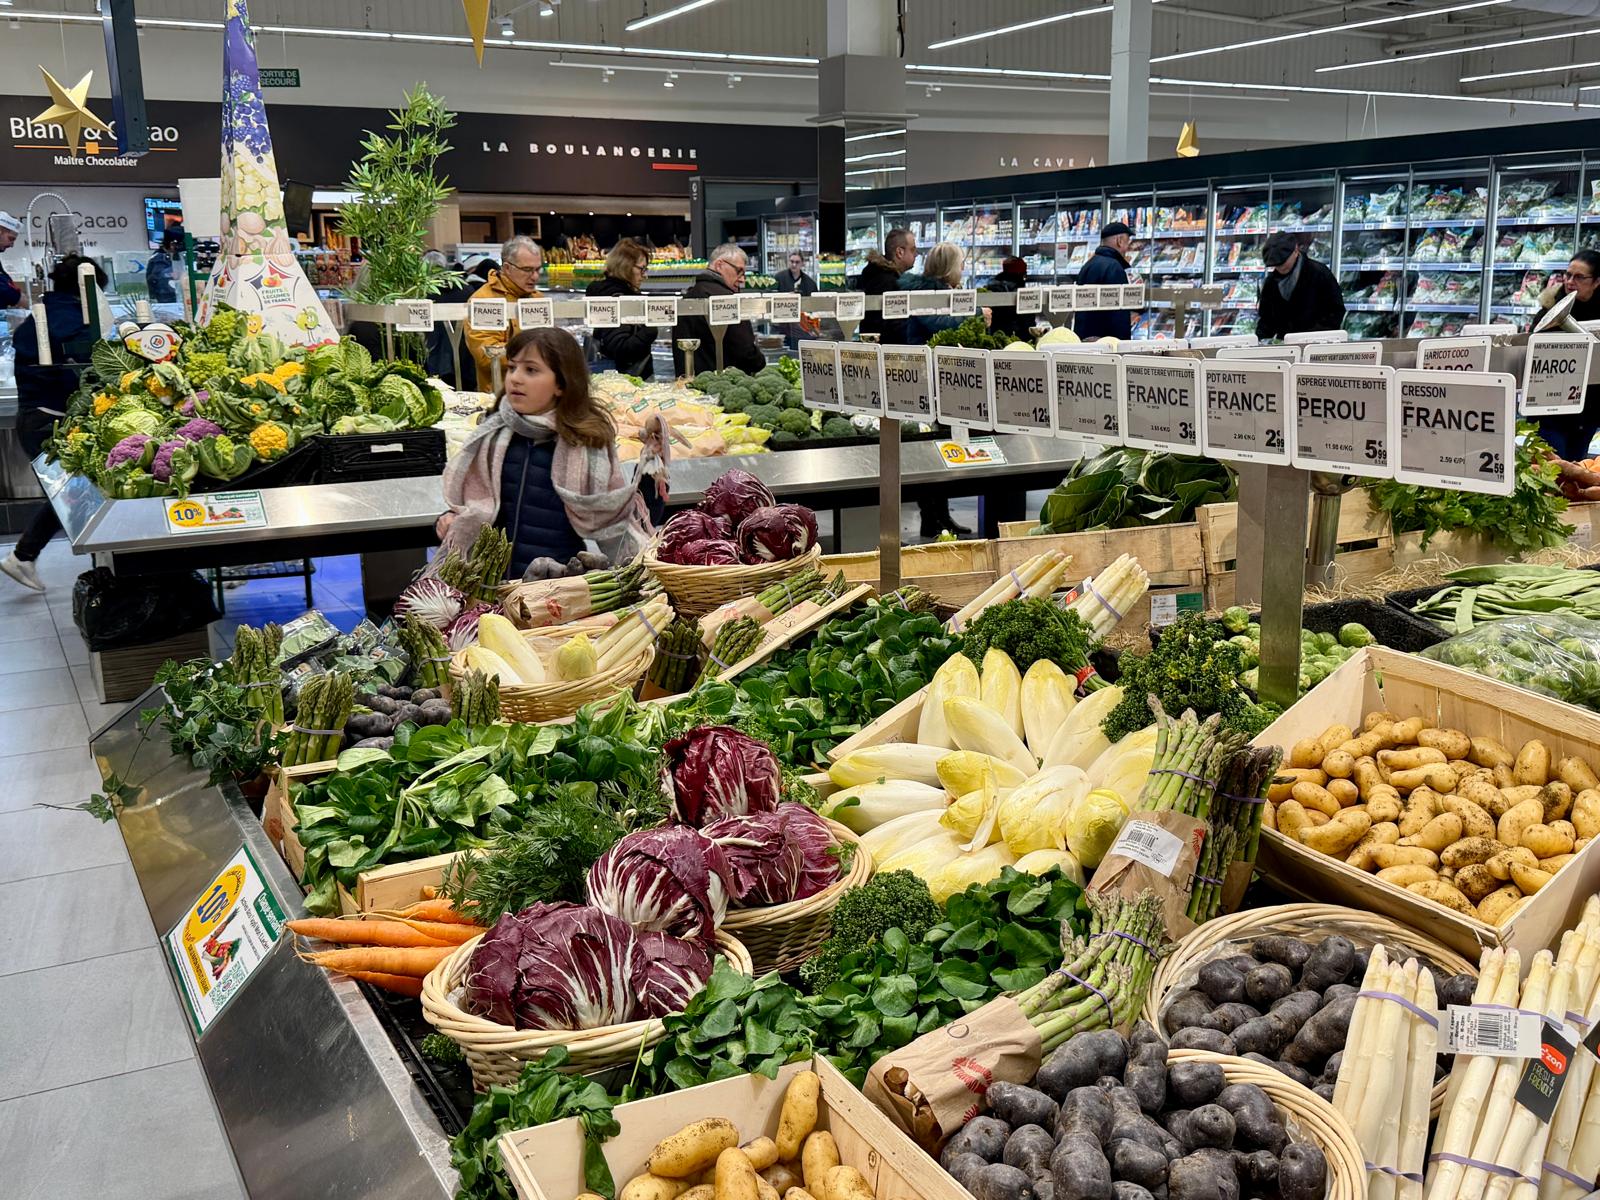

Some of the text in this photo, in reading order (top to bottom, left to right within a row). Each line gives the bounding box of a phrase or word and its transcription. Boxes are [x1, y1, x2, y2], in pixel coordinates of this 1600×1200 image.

[259, 70, 297, 78] SORTIE DE
[260, 78, 297, 86] SECOURS
[10, 118, 64, 139] Blan
[483, 142, 697, 159] LA BOULANGERIE
[86, 156, 138, 167] Chocolatier
[1000, 157, 1018, 167] LA
[1033, 157, 1074, 168] CAVE
[409, 308, 428, 316] ANCE
[474, 308, 502, 316] FRANCE
[648, 304, 672, 312] FRANCE
[1424, 348, 1470, 360] HARICOT COCO
[802, 362, 834, 376] FRANCE
[938, 357, 976, 368] CAROTTES FANE
[994, 362, 1012, 370] MACHE
[1056, 364, 1094, 376] ENDIVE VRAC
[1531, 358, 1576, 374] MAROC
[842, 364, 871, 380] KENYA
[886, 368, 918, 383] PEROU
[1127, 367, 1194, 379] POMME DE TERRE VITTELOTE
[1206, 373, 1246, 384] PDT RATTE
[940, 371, 982, 389] FRANCE
[995, 376, 1044, 394] FRANCE
[1297, 378, 1386, 390] ASPERGE VIOLETTE BOTTE
[1058, 380, 1112, 400] FRANCE
[1128, 384, 1188, 407] FRANCE
[1402, 384, 1446, 398] CRESSON
[1208, 391, 1276, 412] FRANCE
[1298, 396, 1366, 420] PEROU
[1402, 406, 1495, 432] FRANCE
[1364, 440, 1388, 460] 5€99
[1478, 452, 1504, 474] 2€59
[174, 508, 202, 521] 10%
[197, 884, 230, 924] 10%
[258, 892, 272, 914] Chaque
[1532, 1062, 1556, 1087] FRESH &
[1528, 1072, 1554, 1098] FRIENDLY
